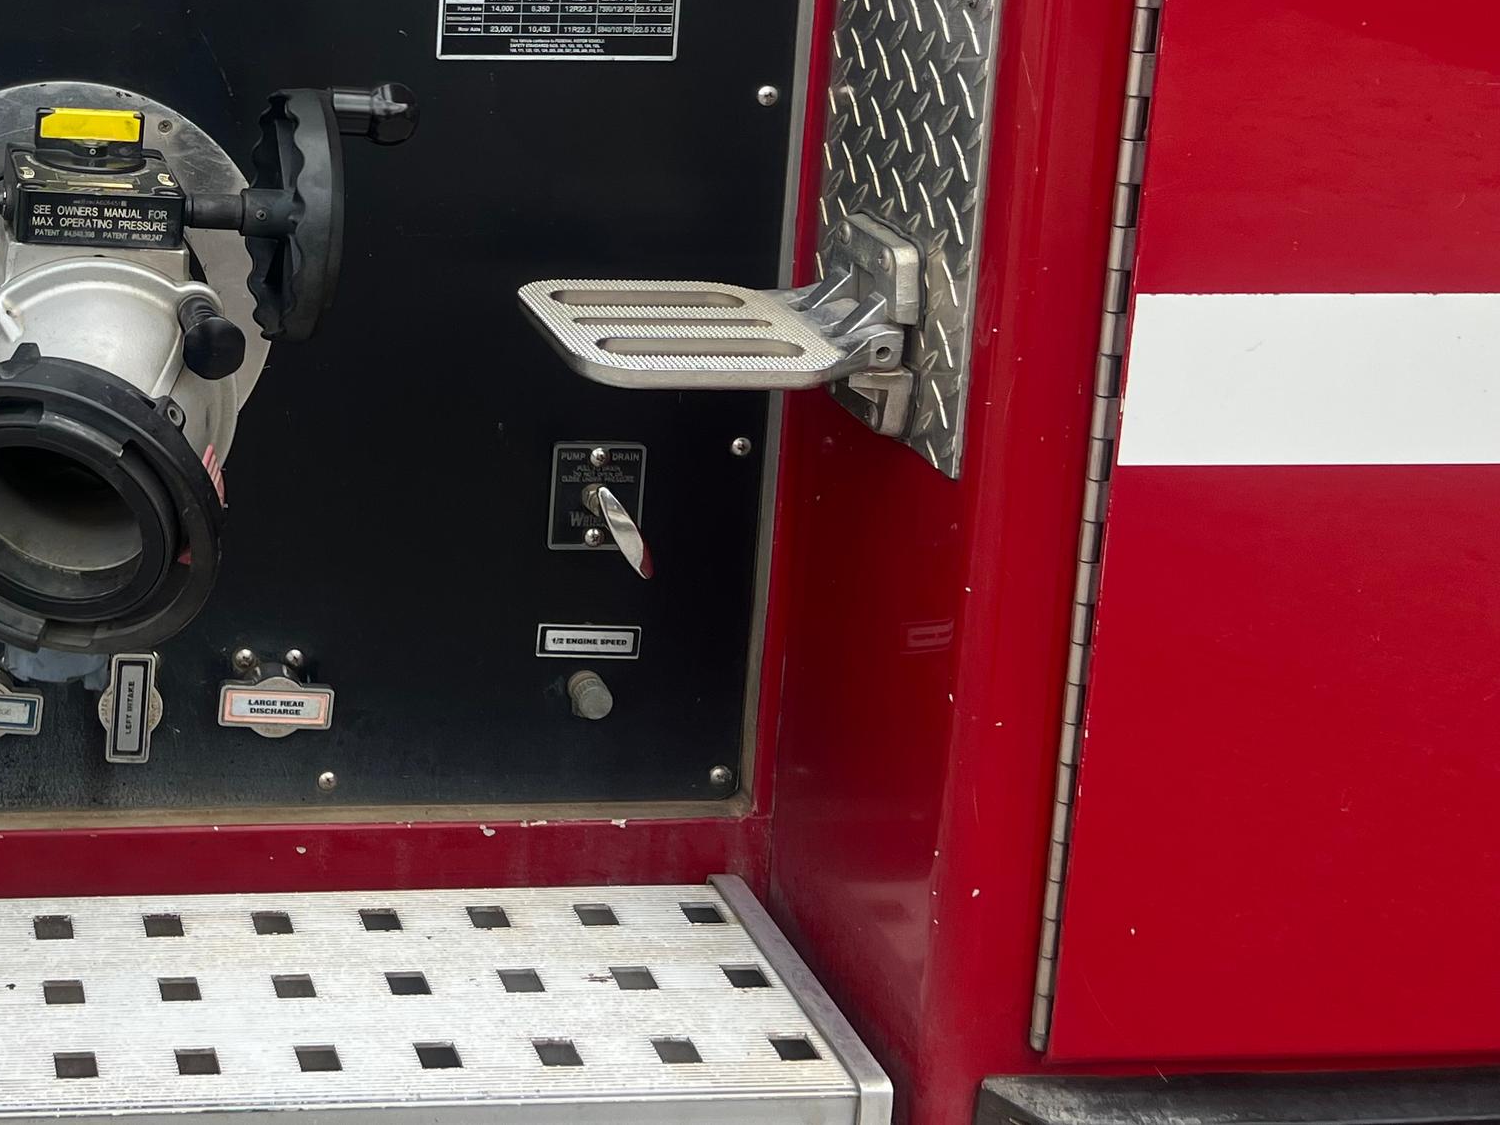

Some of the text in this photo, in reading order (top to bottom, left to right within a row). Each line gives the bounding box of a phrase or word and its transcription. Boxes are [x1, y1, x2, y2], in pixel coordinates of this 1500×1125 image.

[33, 204, 168, 220] SEE OWNERS MANUAL FOR
[31, 216, 167, 232] MAX OPERATING PRESSURE
[34, 229, 128, 240] PATENT PATENT
[561, 452, 640, 461] PUMP DRAIN
[127, 681, 135, 712] INTAKE
[248, 699, 304, 708] LARGE REAR
[249, 707, 301, 716] DISCHARGE
